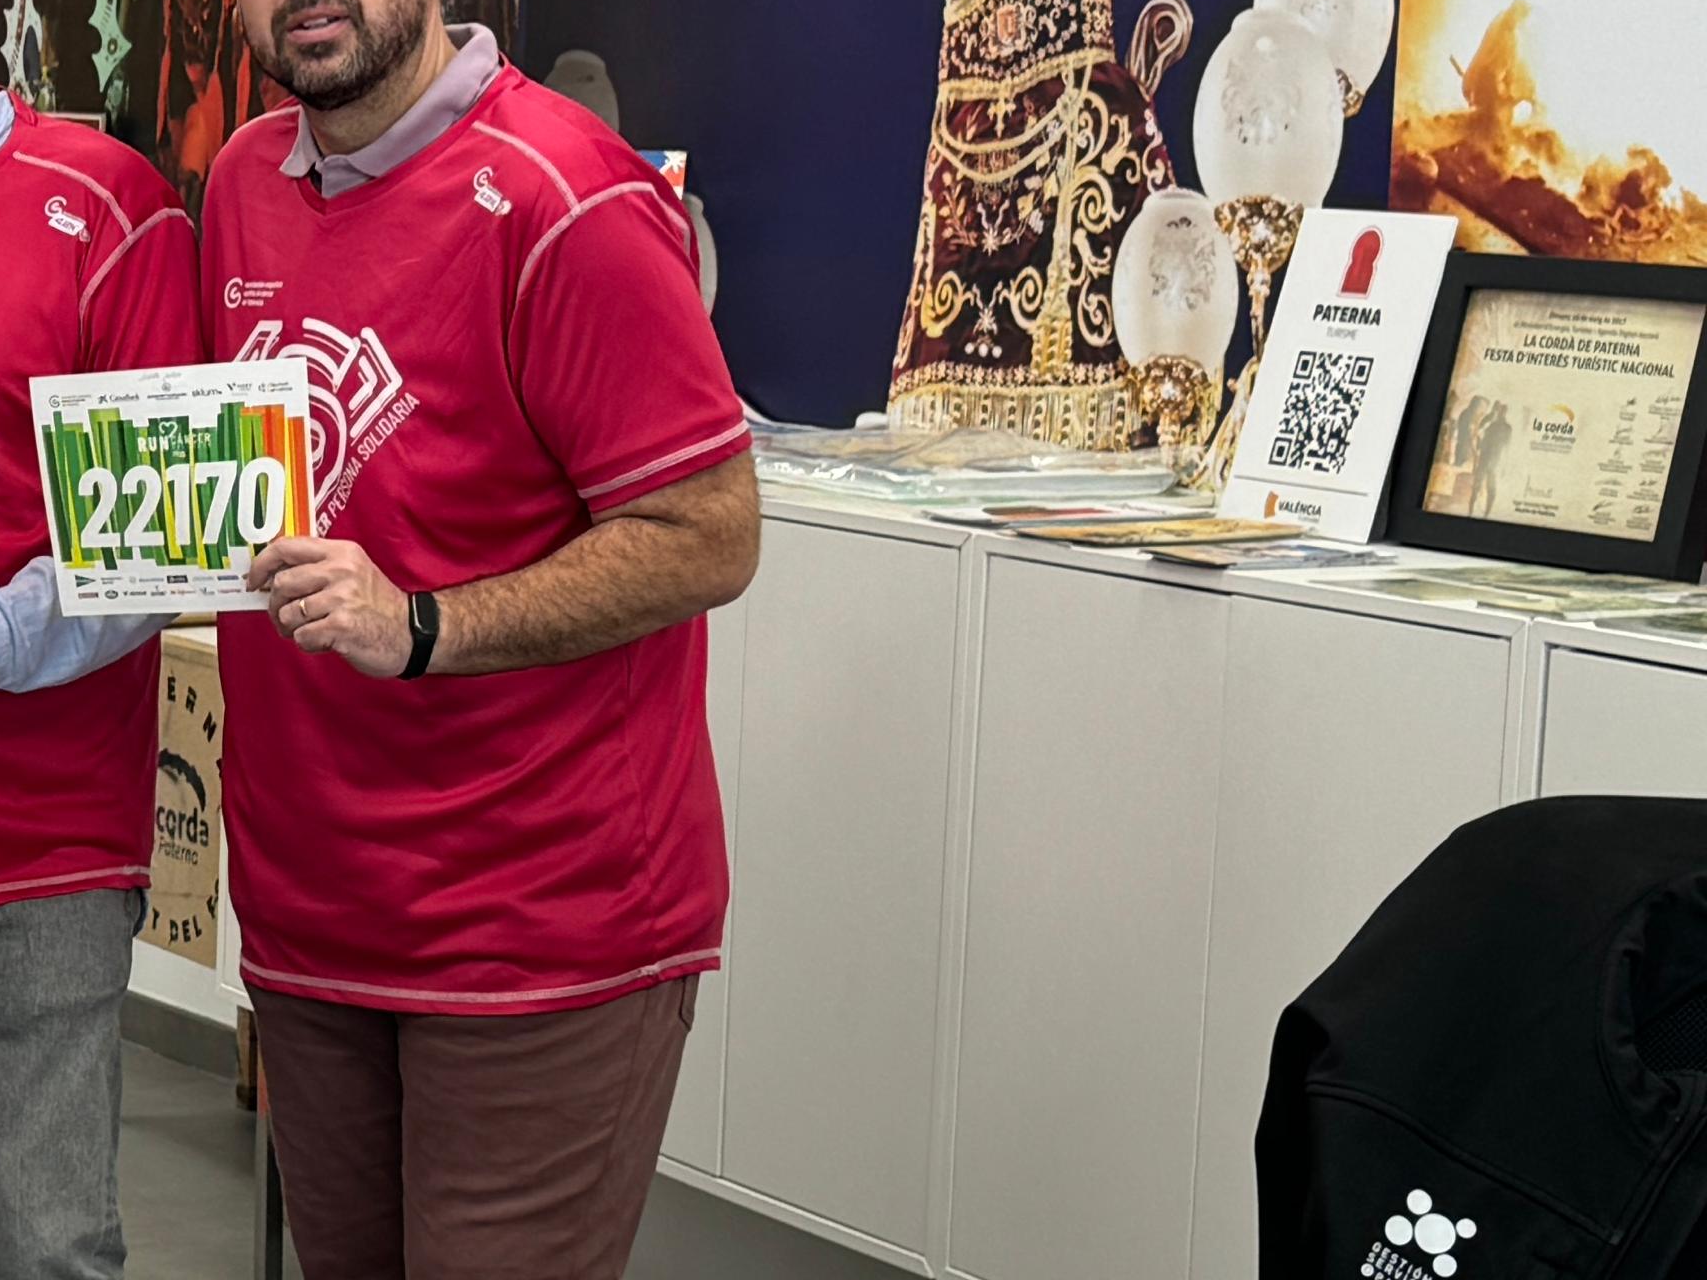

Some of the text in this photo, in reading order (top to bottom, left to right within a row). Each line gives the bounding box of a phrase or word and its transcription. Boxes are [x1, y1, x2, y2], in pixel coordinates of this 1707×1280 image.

[1312, 304, 1381, 326] PATERNA
[1523, 333, 1640, 358] LA CORDÀ DE PATERNA
[1484, 348, 1514, 363] FESTA
[1572, 357, 1618, 373] TURÍSTIC
[1620, 361, 1675, 379] NACIONAL
[137, 435, 169, 453] RUN
[327, 391, 421, 519] PERSONA SOLIDARIA
[78, 456, 286, 549] 22170
